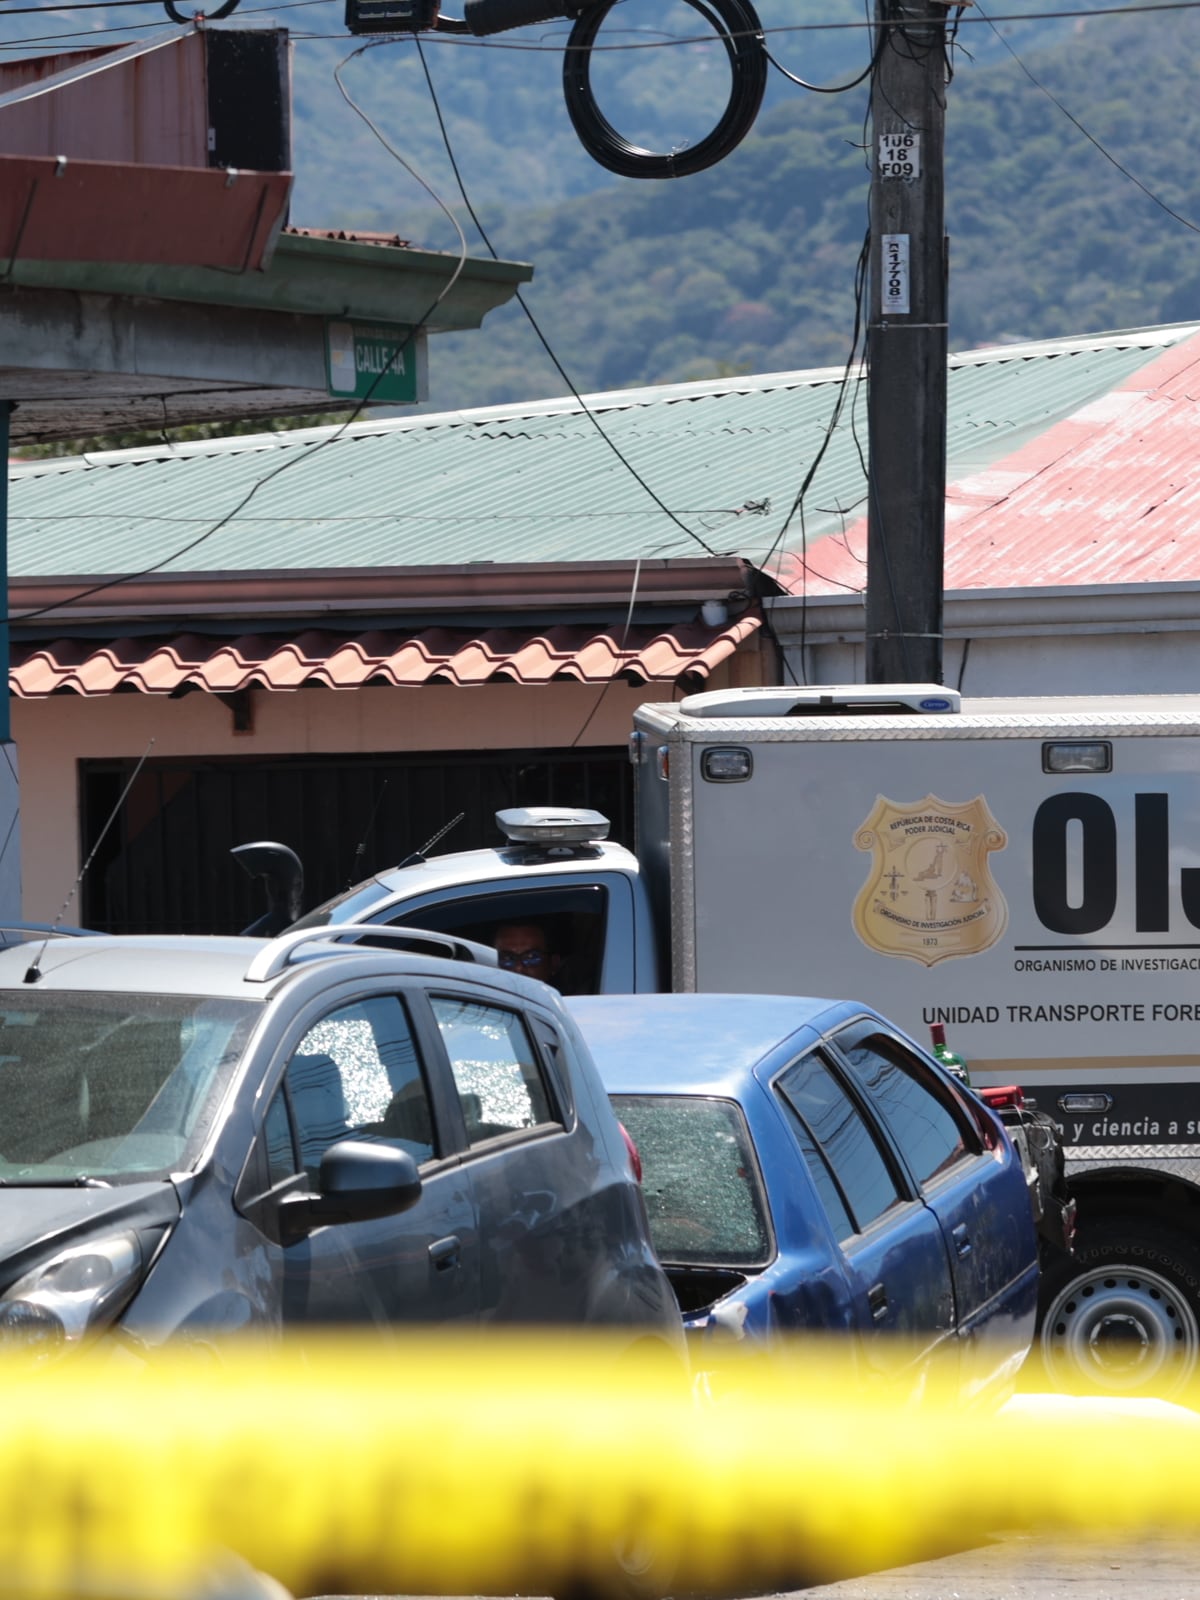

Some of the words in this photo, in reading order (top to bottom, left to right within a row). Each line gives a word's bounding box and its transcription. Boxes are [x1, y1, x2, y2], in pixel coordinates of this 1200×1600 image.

[887, 149, 907, 161] 18
[882, 163, 914, 176] F09
[356, 344, 389, 374] CALLE
[890, 816, 923, 831] REPÚBLICA
[924, 815, 934, 823] DE
[934, 816, 956, 826] COSTA
[956, 820, 971, 833] RICA
[905, 825, 927, 835] PODER
[927, 825, 956, 835] JUDICIAL
[879, 908, 912, 926] ORGANISMO
[911, 919, 920, 928] DE
[962, 908, 985, 924] JUDICIAL
[1014, 959, 1096, 972] ORGANISMO
[1100, 959, 1117, 971] DE
[922, 1006, 1000, 1024] UNIDAD
[1006, 1004, 1145, 1022] TRANSPORTE
[1072, 1123, 1084, 1143] y
[1092, 1116, 1160, 1136] ciencia
[1168, 1121, 1178, 1135] a
